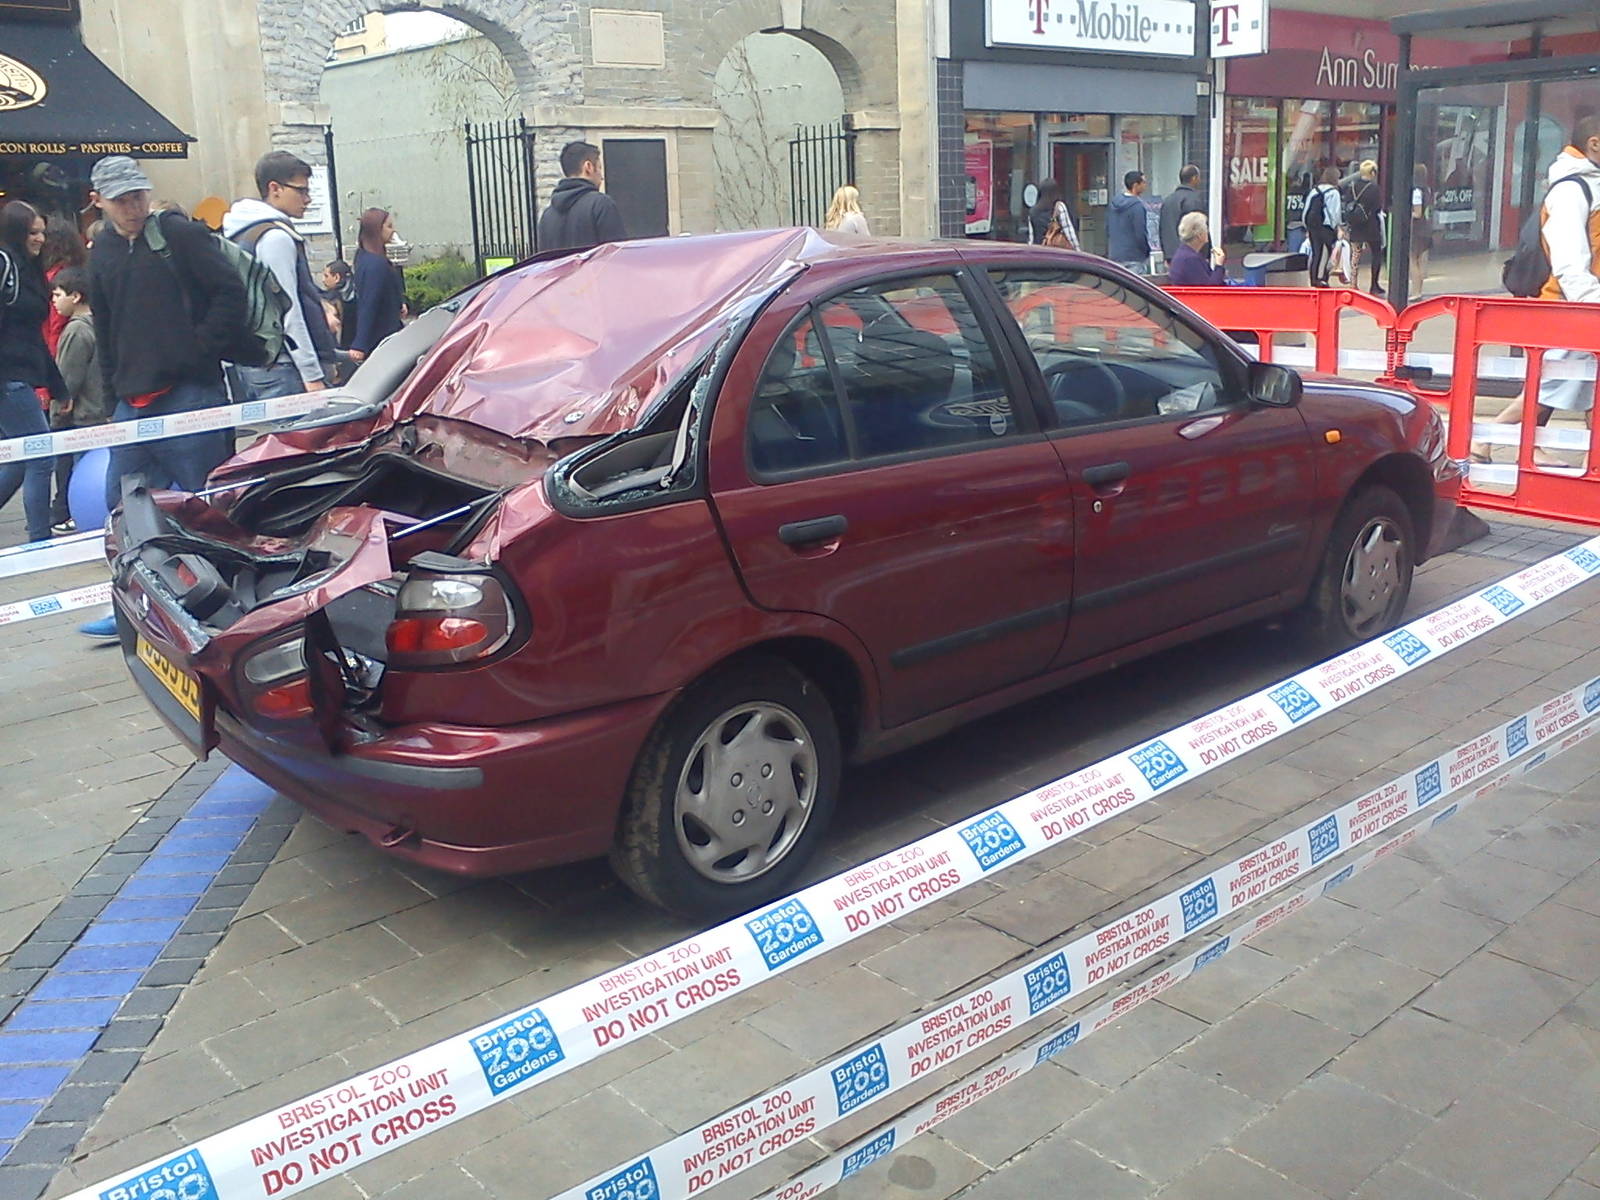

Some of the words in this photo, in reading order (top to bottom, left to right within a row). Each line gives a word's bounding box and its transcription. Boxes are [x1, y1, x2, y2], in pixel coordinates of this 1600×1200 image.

[1076, 1, 1151, 42] Mobile
[1213, 5, 1239, 47] T
[1316, 46, 1358, 87] Ann
[30, 143, 66, 154] ROLLS
[81, 143, 132, 153] PASTRIES
[142, 143, 183, 153] COFFEE
[1229, 157, 1268, 184] SALE
[1391, 635, 1420, 658] ZOO
[1192, 713, 1227, 731] BRISTOL
[1227, 705, 1246, 716] ZOO
[1276, 688, 1310, 714] ZOO
[1188, 718, 1250, 749] INVESTIGATION
[1250, 708, 1267, 721] UNIT
[1200, 749, 1218, 765] DO
[1217, 737, 1240, 757] NOT
[1241, 721, 1277, 744] CROSS
[1130, 742, 1166, 764] Bristol
[1138, 748, 1176, 778] ZOO
[1451, 774, 1461, 788] DO
[1462, 766, 1476, 782] NOT
[1477, 754, 1500, 773] CROSS
[1036, 781, 1080, 802] BRISTOL
[1079, 770, 1102, 784] ZOO
[1151, 765, 1184, 786] Gardens
[1417, 772, 1440, 796] ZOO
[1030, 784, 1104, 822] INVESTIGATION
[1104, 773, 1126, 789] UNIT
[1041, 822, 1062, 840] DO
[1062, 808, 1090, 830] NOT
[1092, 788, 1135, 816] CROSS
[1349, 798, 1394, 828] INVESTIGATION
[1396, 790, 1408, 803] UNIT
[1357, 792, 1383, 810] BRISTOL
[1384, 784, 1397, 797] ZOO
[962, 814, 1003, 840] Bristol
[969, 822, 1014, 857] ZOO
[1308, 818, 1334, 838] Bristol
[1310, 826, 1337, 853] ZOO
[1351, 828, 1362, 843] DO
[1364, 818, 1380, 836] NOT
[1382, 804, 1408, 825] CROSS
[844, 860, 898, 886] BRISTOL
[897, 848, 924, 864] ZOO
[982, 841, 1021, 866] Gardens
[1230, 856, 1283, 890] INVESTIGATION
[1285, 847, 1299, 862] UNIT
[1239, 850, 1270, 871] BRISTOL
[1271, 841, 1287, 856] ZOO
[834, 864, 926, 911] INVESTIGATION
[926, 852, 952, 870] UNIT
[844, 910, 870, 932] DO
[872, 893, 904, 920] NOT
[909, 869, 960, 902] CROSS
[1181, 881, 1212, 905] Bristol
[1232, 891, 1245, 908] DO
[1248, 879, 1266, 899] NOT
[1269, 862, 1299, 887] CROSS
[749, 901, 801, 935] Bristol
[1182, 890, 1216, 922] ZOO
[1184, 908, 1215, 929] Gardens
[757, 911, 812, 954] ZOO
[1085, 925, 1150, 965] INVESTIGATION
[1152, 914, 1169, 932] UNIT
[1096, 920, 1134, 944] BRISTOL
[1135, 909, 1154, 925] ZOO
[599, 960, 667, 992] BRISTOL
[668, 943, 700, 963] ZOO
[769, 934, 818, 964] Gardens
[1088, 966, 1104, 984] DO
[1107, 952, 1128, 974] NOT
[1133, 932, 1169, 959] CROSS
[582, 963, 700, 1022] INVESTIGATION
[701, 948, 732, 970] UNIT
[1025, 956, 1063, 984] Bristol
[1027, 965, 1068, 1002] ZOO
[593, 1020, 624, 1047] DO
[628, 998, 669, 1032] NOT
[676, 969, 740, 1008] CROSS
[1030, 986, 1068, 1010] Gardens
[1112, 985, 1149, 1011] BRISTOL
[1151, 972, 1170, 989] ZOO
[908, 1008, 988, 1056] INVESTIGATION
[990, 996, 1011, 1016] UNIT
[922, 1004, 967, 1031] BRISTOL
[970, 991, 992, 1009] ZOO
[474, 1012, 542, 1051] Bristol
[482, 1024, 554, 1076] ZOO
[911, 1057, 930, 1078] DO
[935, 1040, 962, 1065] NOT
[967, 1015, 1011, 1047] CROSS
[1041, 1027, 1077, 1057] Bristol
[494, 1050, 558, 1087] Gardens
[833, 1048, 880, 1082] Bristol
[835, 1058, 886, 1102] ZOO
[278, 1086, 366, 1128] BRISTOL
[368, 1065, 410, 1091] ZOO
[838, 1082, 886, 1110] Gardens
[936, 1082, 981, 1113] BRISTOL
[984, 1066, 1006, 1087] ZOO
[252, 1088, 406, 1166] INVESTIGATION
[410, 1069, 448, 1098] UNIT
[684, 1111, 785, 1170] INVESTIGATION
[788, 1096, 815, 1120] UNIT
[702, 1107, 758, 1142] BRISTOL
[762, 1091, 791, 1113] ZOO
[262, 1162, 302, 1196] DO
[310, 1133, 361, 1175] NOT
[373, 1095, 456, 1145] CROSS
[689, 1170, 712, 1193] DO
[719, 1148, 751, 1178] NOT
[759, 1117, 815, 1156] CROSS
[847, 1133, 892, 1167] Bristol
[108, 1153, 197, 1200] Bristol
[591, 1162, 649, 1200] Bristol
[776, 1181, 804, 1200] ZOO
